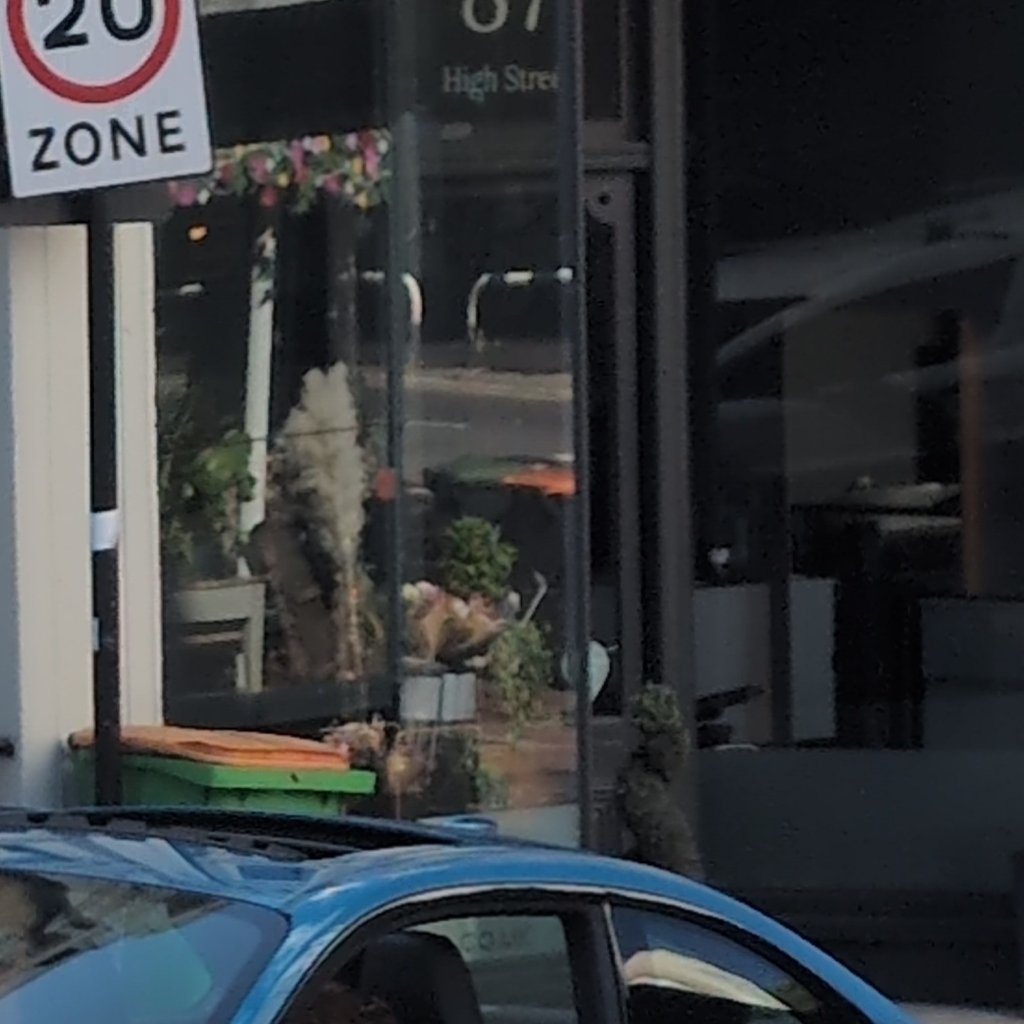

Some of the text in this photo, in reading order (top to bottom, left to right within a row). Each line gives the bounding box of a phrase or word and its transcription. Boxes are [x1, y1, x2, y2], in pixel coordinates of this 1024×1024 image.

[38, 0, 153, 50] 20
[443, 66, 497, 102] High
[28, 109, 186, 172] ZONE
